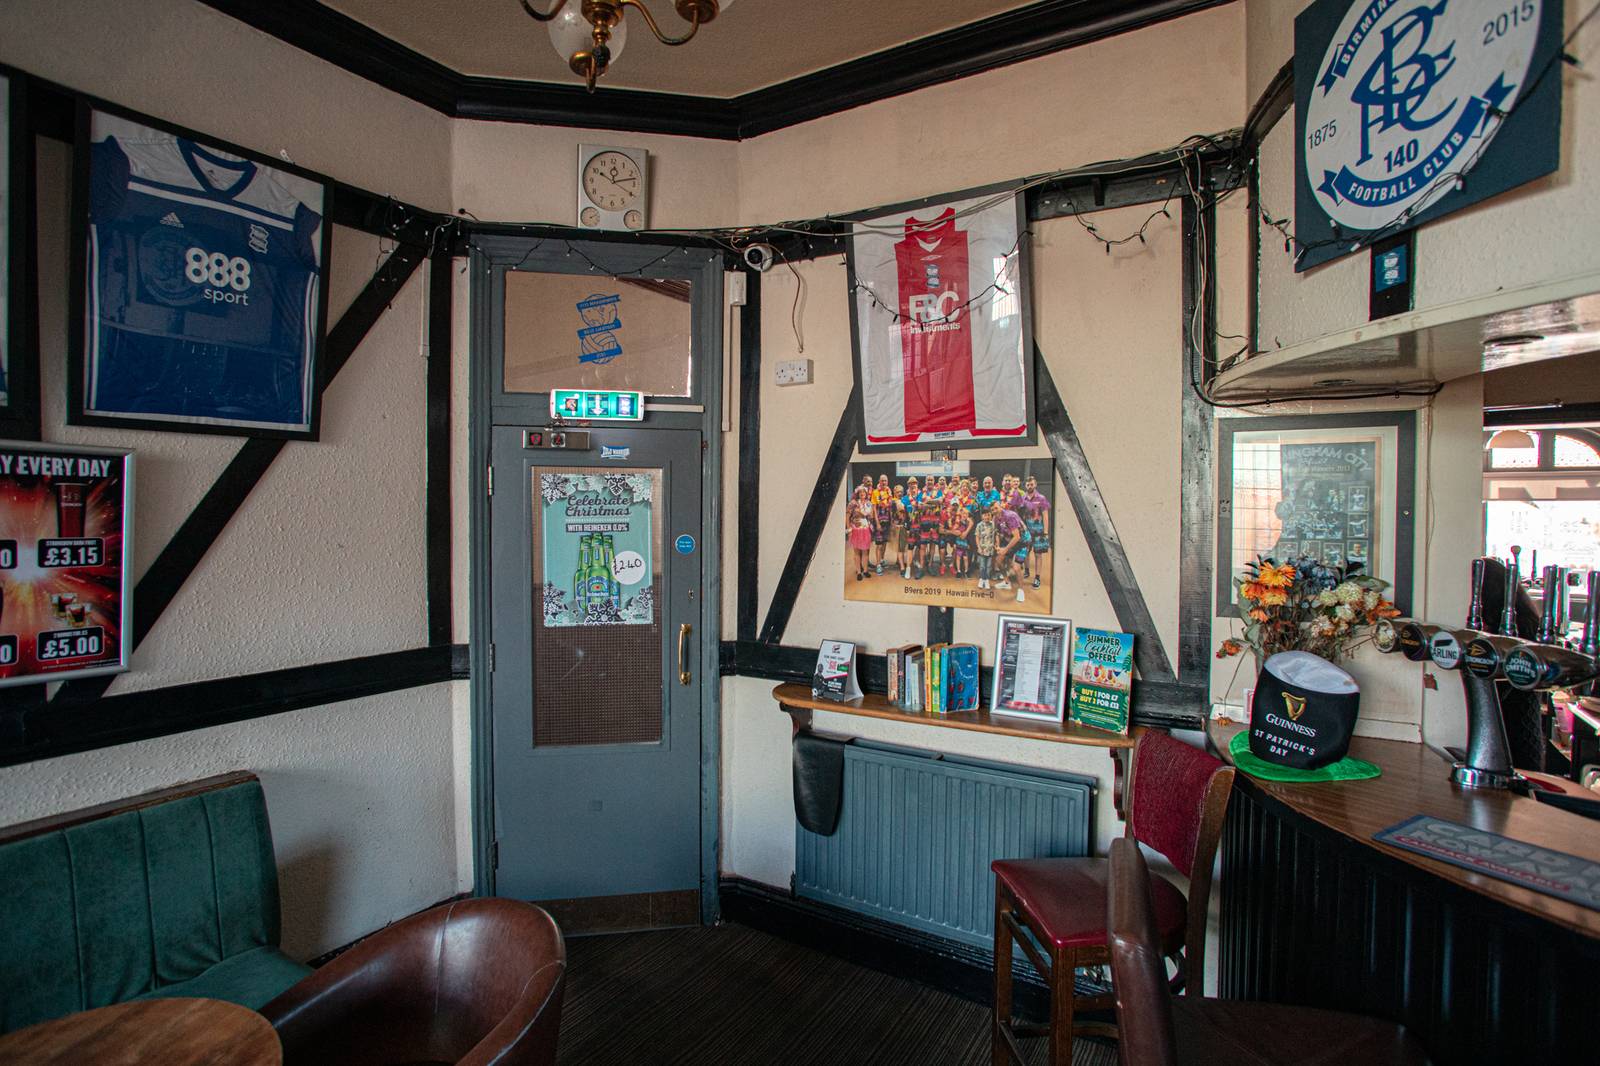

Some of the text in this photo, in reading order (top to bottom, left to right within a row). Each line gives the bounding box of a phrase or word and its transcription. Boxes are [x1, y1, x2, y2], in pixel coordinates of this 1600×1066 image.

[1482, 0, 1535, 46] 2015
[1308, 118, 1337, 150] 1875
[1384, 138, 1419, 173] 140
[1347, 132, 1464, 202] FOOTBALL CLUB
[185, 247, 250, 292] 888
[203, 288, 249, 306] sport
[17, 455, 75, 477] EVERY
[78, 457, 111, 478] DAY
[567, 494, 631, 507] Celebrate
[565, 504, 632, 517] Christmas
[567, 523, 628, 532] WITH HEINEKEN 0.0%
[44, 546, 98, 567] £3.15
[904, 586, 924, 595] B9ers
[924, 587, 942, 596] 2019
[945, 588, 970, 598] Hawaii
[42, 635, 100, 659] £5.00
[1084, 640, 1122, 656] Cocktail
[1086, 634, 1120, 646] SUMMER
[1088, 652, 1117, 663] OFFERS
[1509, 657, 1532, 668] JOHN
[1505, 663, 1537, 679] SMITH'S
[1079, 695, 1092, 704] BUY
[1096, 698, 1109, 707] FOR
[1081, 687, 1093, 697] BUY
[1097, 691, 1110, 700] FOR
[1265, 712, 1317, 738] GUINNESS
[1254, 728, 1316, 756] ST PATRICK'S
[1270, 744, 1289, 757] DAY
